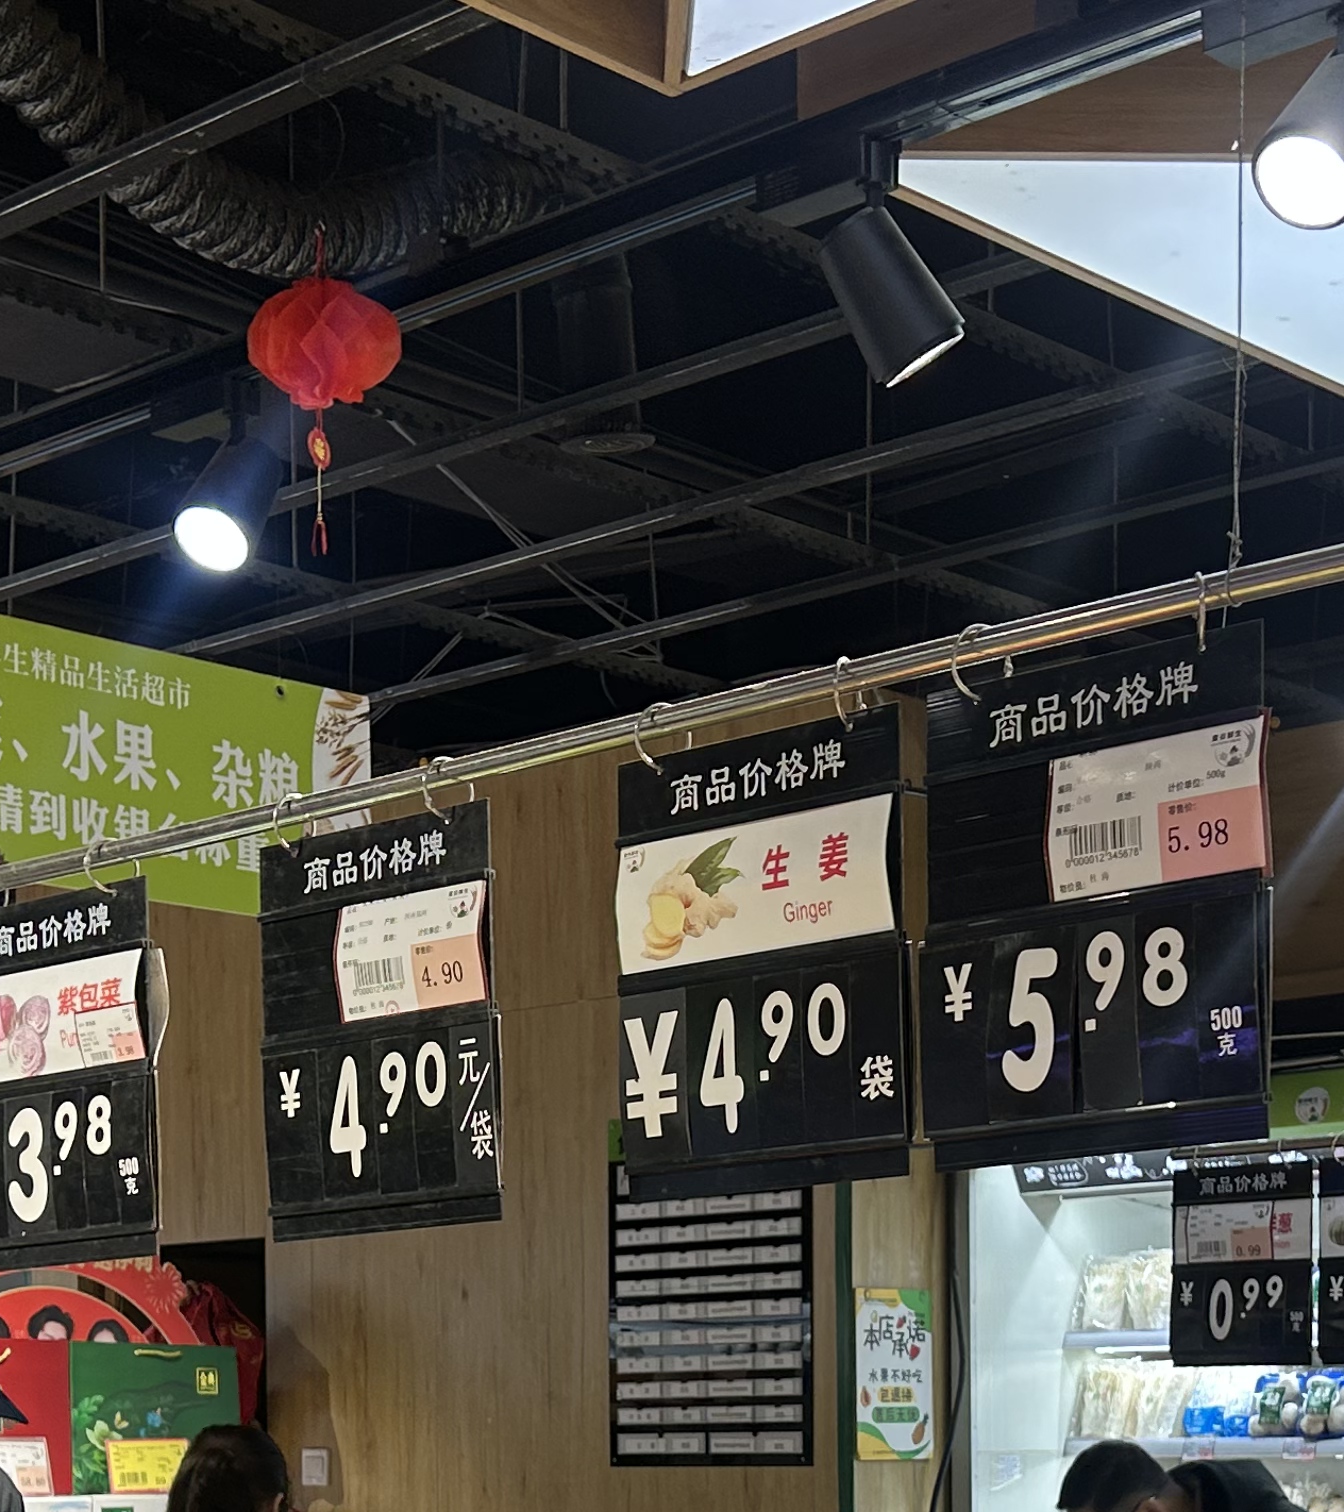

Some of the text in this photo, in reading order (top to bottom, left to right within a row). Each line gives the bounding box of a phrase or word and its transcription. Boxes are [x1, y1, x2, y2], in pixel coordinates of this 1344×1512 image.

[989, 660, 1199, 749] 商品价格牌
[669, 738, 847, 816] 商品价格牌
[1167, 817, 1229, 854] 5.98
[303, 829, 448, 896] 商品价格牌
[783, 899, 834, 924] Ginger
[421, 960, 464, 988] 4.90
[57, 977, 122, 1016] 紫包菜
[943, 926, 1189, 1092] ¥ 5.98
[1209, 1005, 1244, 1031] 500
[622, 982, 895, 1139] ¥ 4.90 袋
[1217, 1033, 1238, 1057] 克
[279, 1068, 302, 1119] ¥
[329, 1041, 447, 1178] 4.90
[8, 1094, 112, 1223] 3.98
[118, 1156, 140, 1177] 500
[124, 1177, 140, 1196] 克
[1199, 1170, 1288, 1197] 商品价格牌
[1179, 1274, 1284, 1342] ¥ 0.99
[1329, 1275, 1344, 1303] ¥
[863, 1314, 927, 1359] 本店承诺
